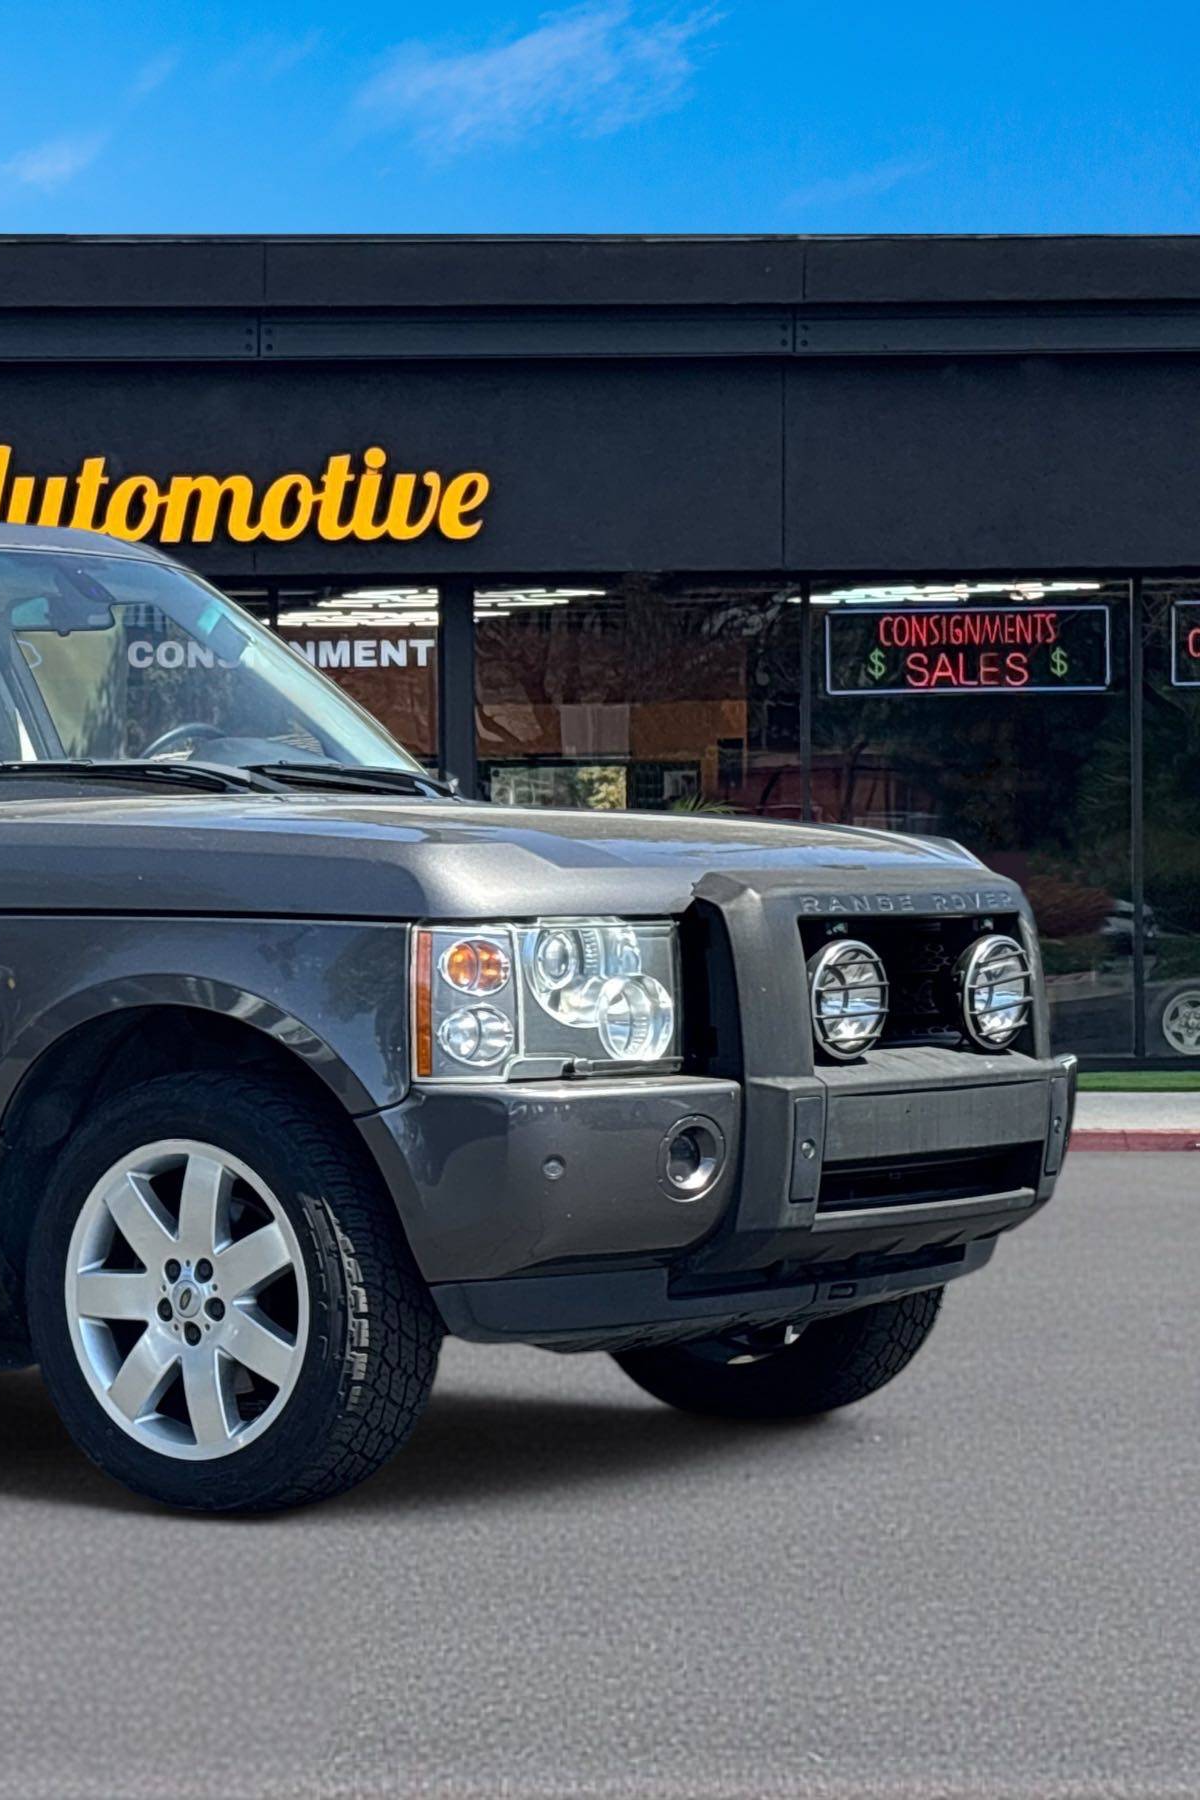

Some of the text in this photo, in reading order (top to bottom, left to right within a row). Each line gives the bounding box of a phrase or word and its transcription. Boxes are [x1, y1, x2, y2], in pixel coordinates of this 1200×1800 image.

[879, 613, 1057, 646] CONSIGNMENTS
[127, 638, 436, 669] CONNMENT
[906, 653, 1029, 687] SALES
[801, 894, 915, 913] RANGE
